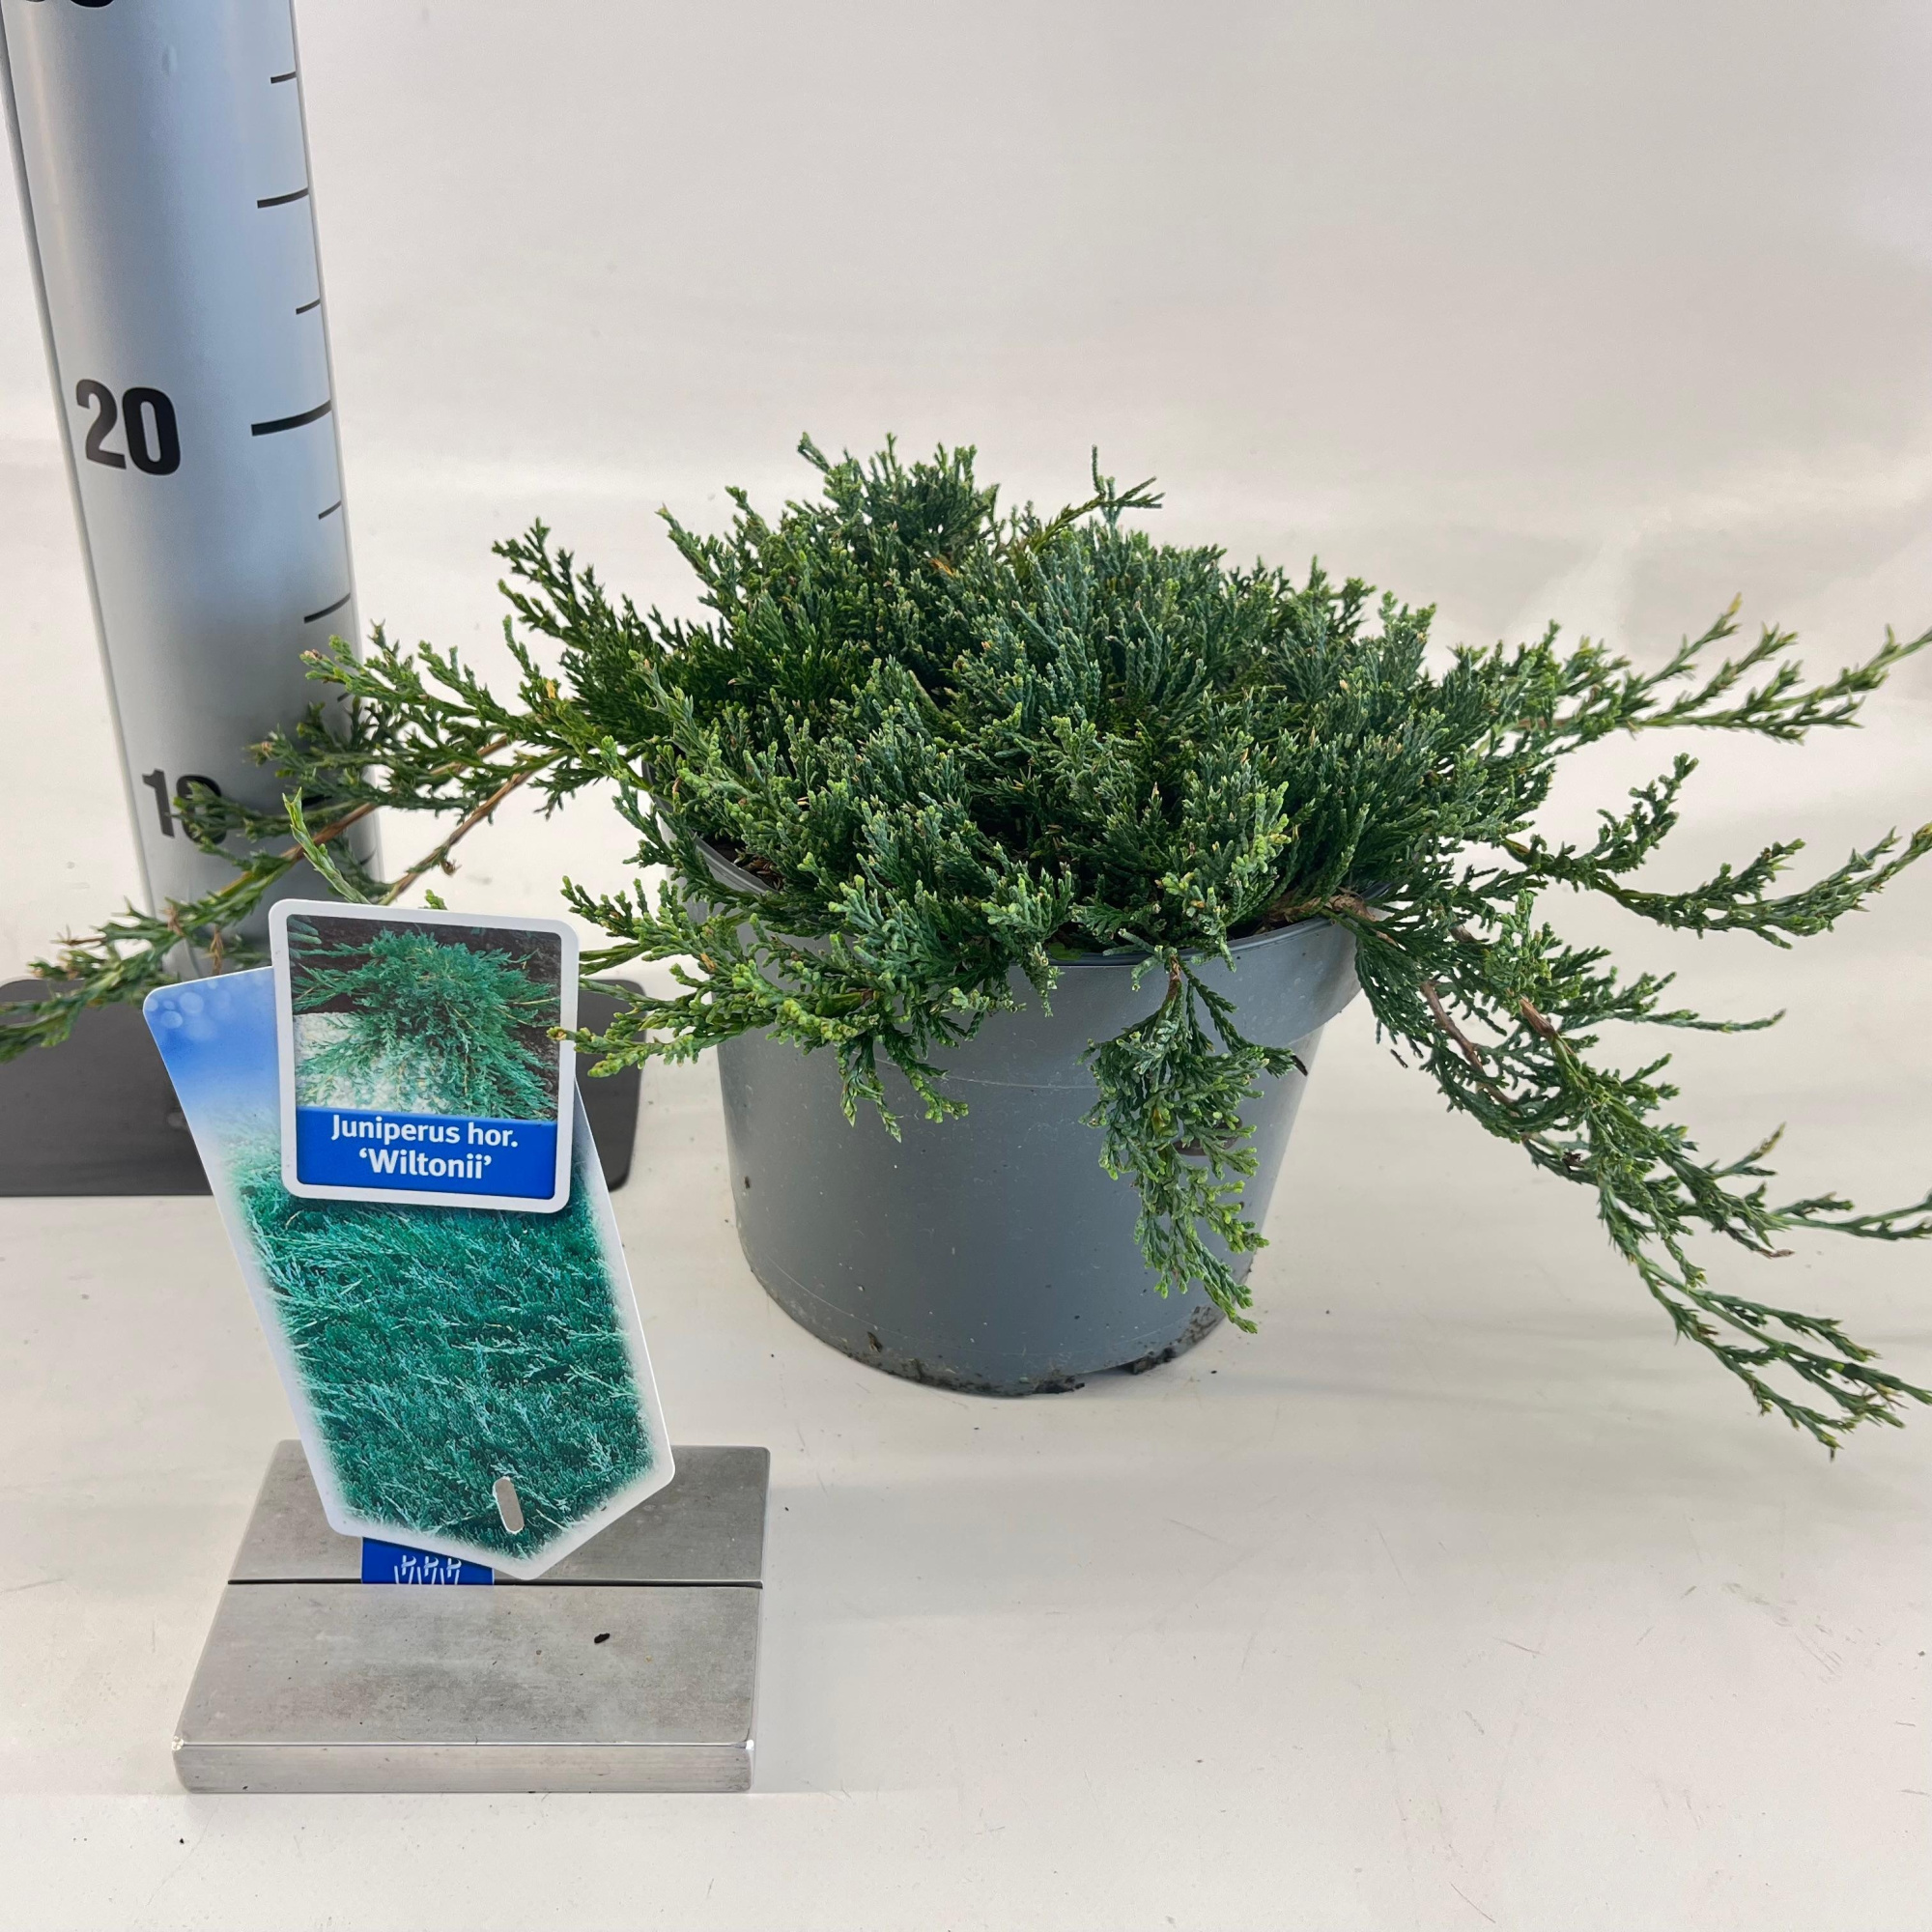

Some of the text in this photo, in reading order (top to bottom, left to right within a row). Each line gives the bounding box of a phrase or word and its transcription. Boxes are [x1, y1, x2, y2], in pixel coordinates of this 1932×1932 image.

[76, 379, 181, 475] 20
[331, 1114, 519, 1148] Juniperus hor.
[358, 1148, 492, 1179] ‘Wiltonii’
